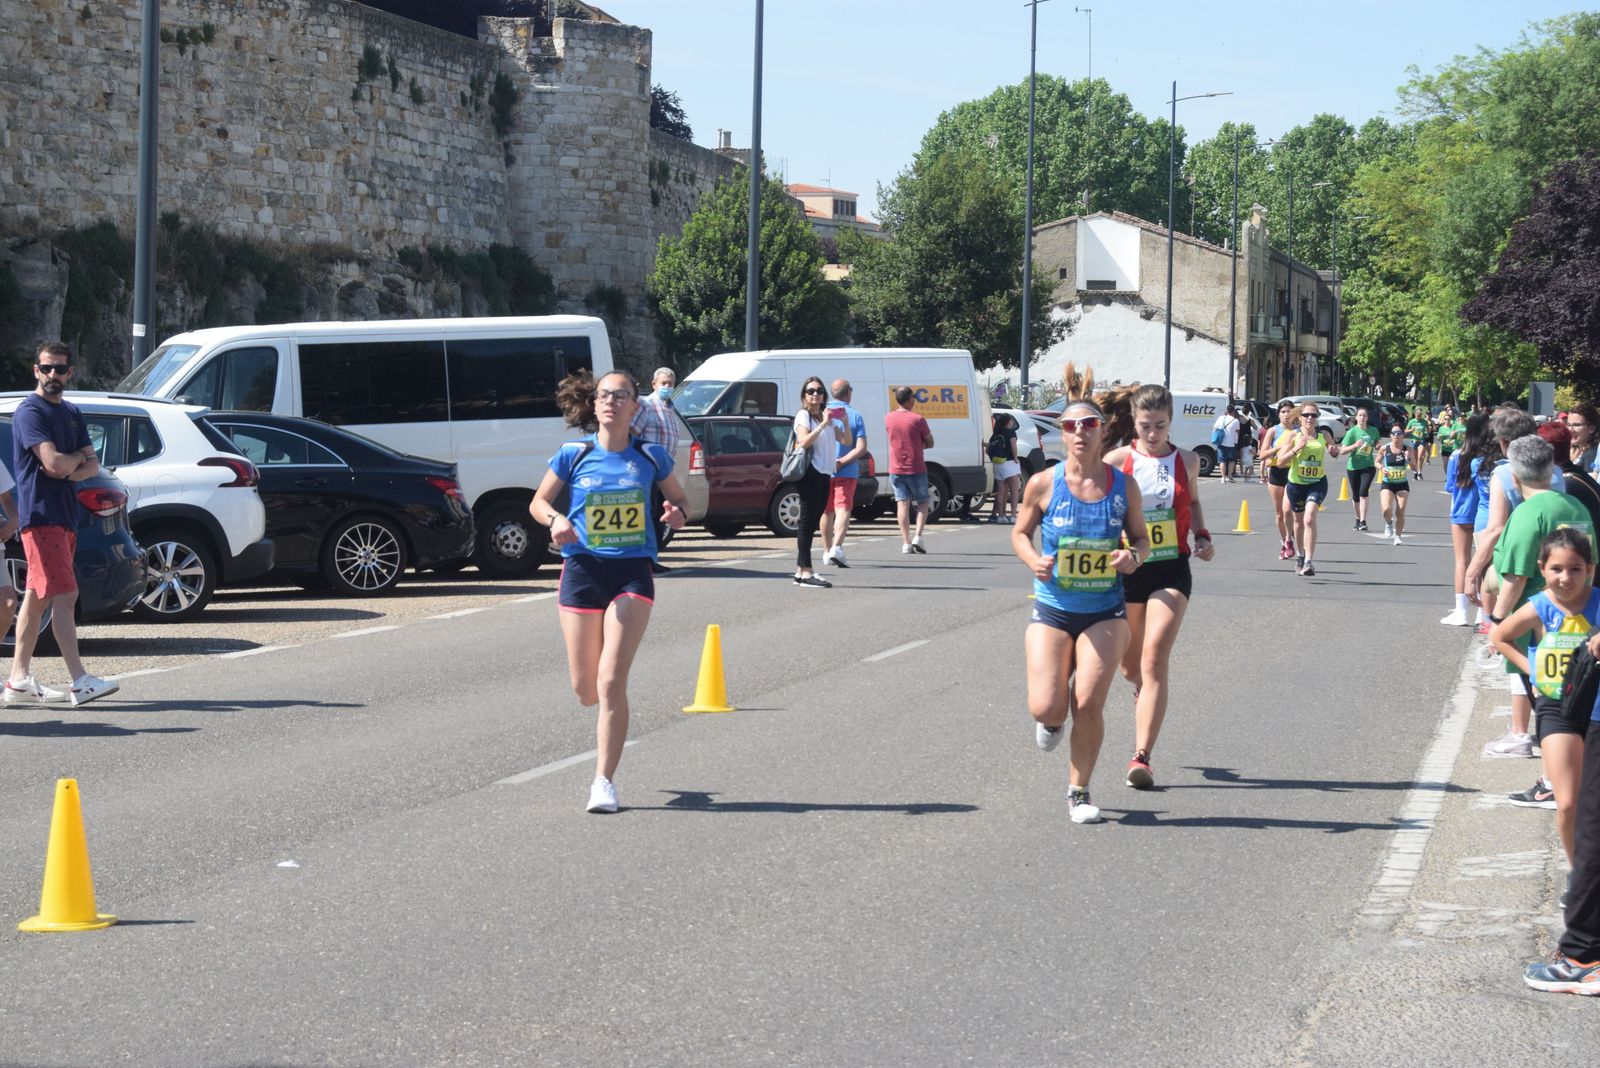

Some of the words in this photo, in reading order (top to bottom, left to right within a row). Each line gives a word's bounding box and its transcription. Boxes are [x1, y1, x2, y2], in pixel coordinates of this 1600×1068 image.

[1183, 403, 1216, 415] Hertz
[1301, 467, 1318, 477] 190
[592, 507, 639, 531] 242
[1151, 524, 1164, 545] 6
[1065, 552, 1108, 575] 164
